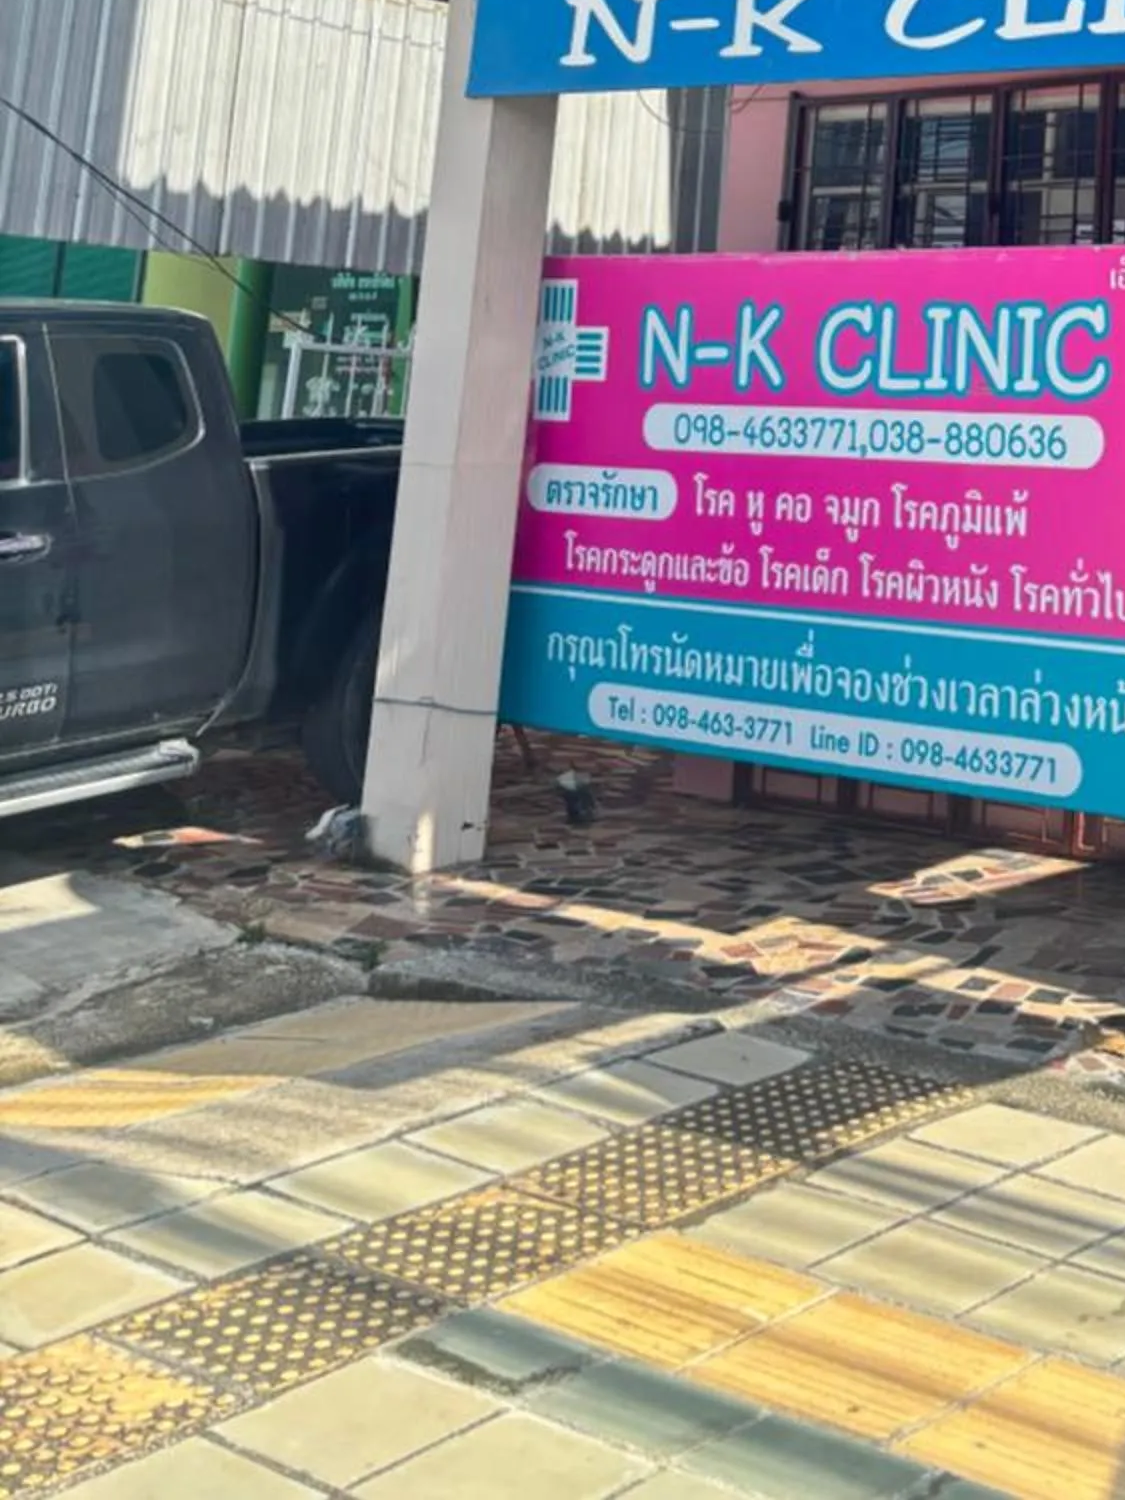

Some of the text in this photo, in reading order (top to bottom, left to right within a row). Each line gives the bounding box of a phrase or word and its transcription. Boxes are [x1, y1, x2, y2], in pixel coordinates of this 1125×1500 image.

[536, 343, 577, 371] CLINIC
[640, 298, 1112, 401] N-K CLINIC
[674, 412, 1068, 461] 098-4633771,038-880636
[546, 470, 1030, 550] ตรวจรักษา โรค หู คอ จมูก โรคภูมิแพ้
[563, 529, 750, 593] โรคกระดูกและข้อ
[758, 544, 849, 596] โรคเด็ก
[858, 551, 999, 610] โรคผิวหนัง
[607, 695, 635, 721] Tel
[653, 702, 794, 745] 098-463-3771
[809, 724, 850, 754] Line
[857, 731, 881, 758] ID
[901, 738, 1057, 784] 098-4633771
